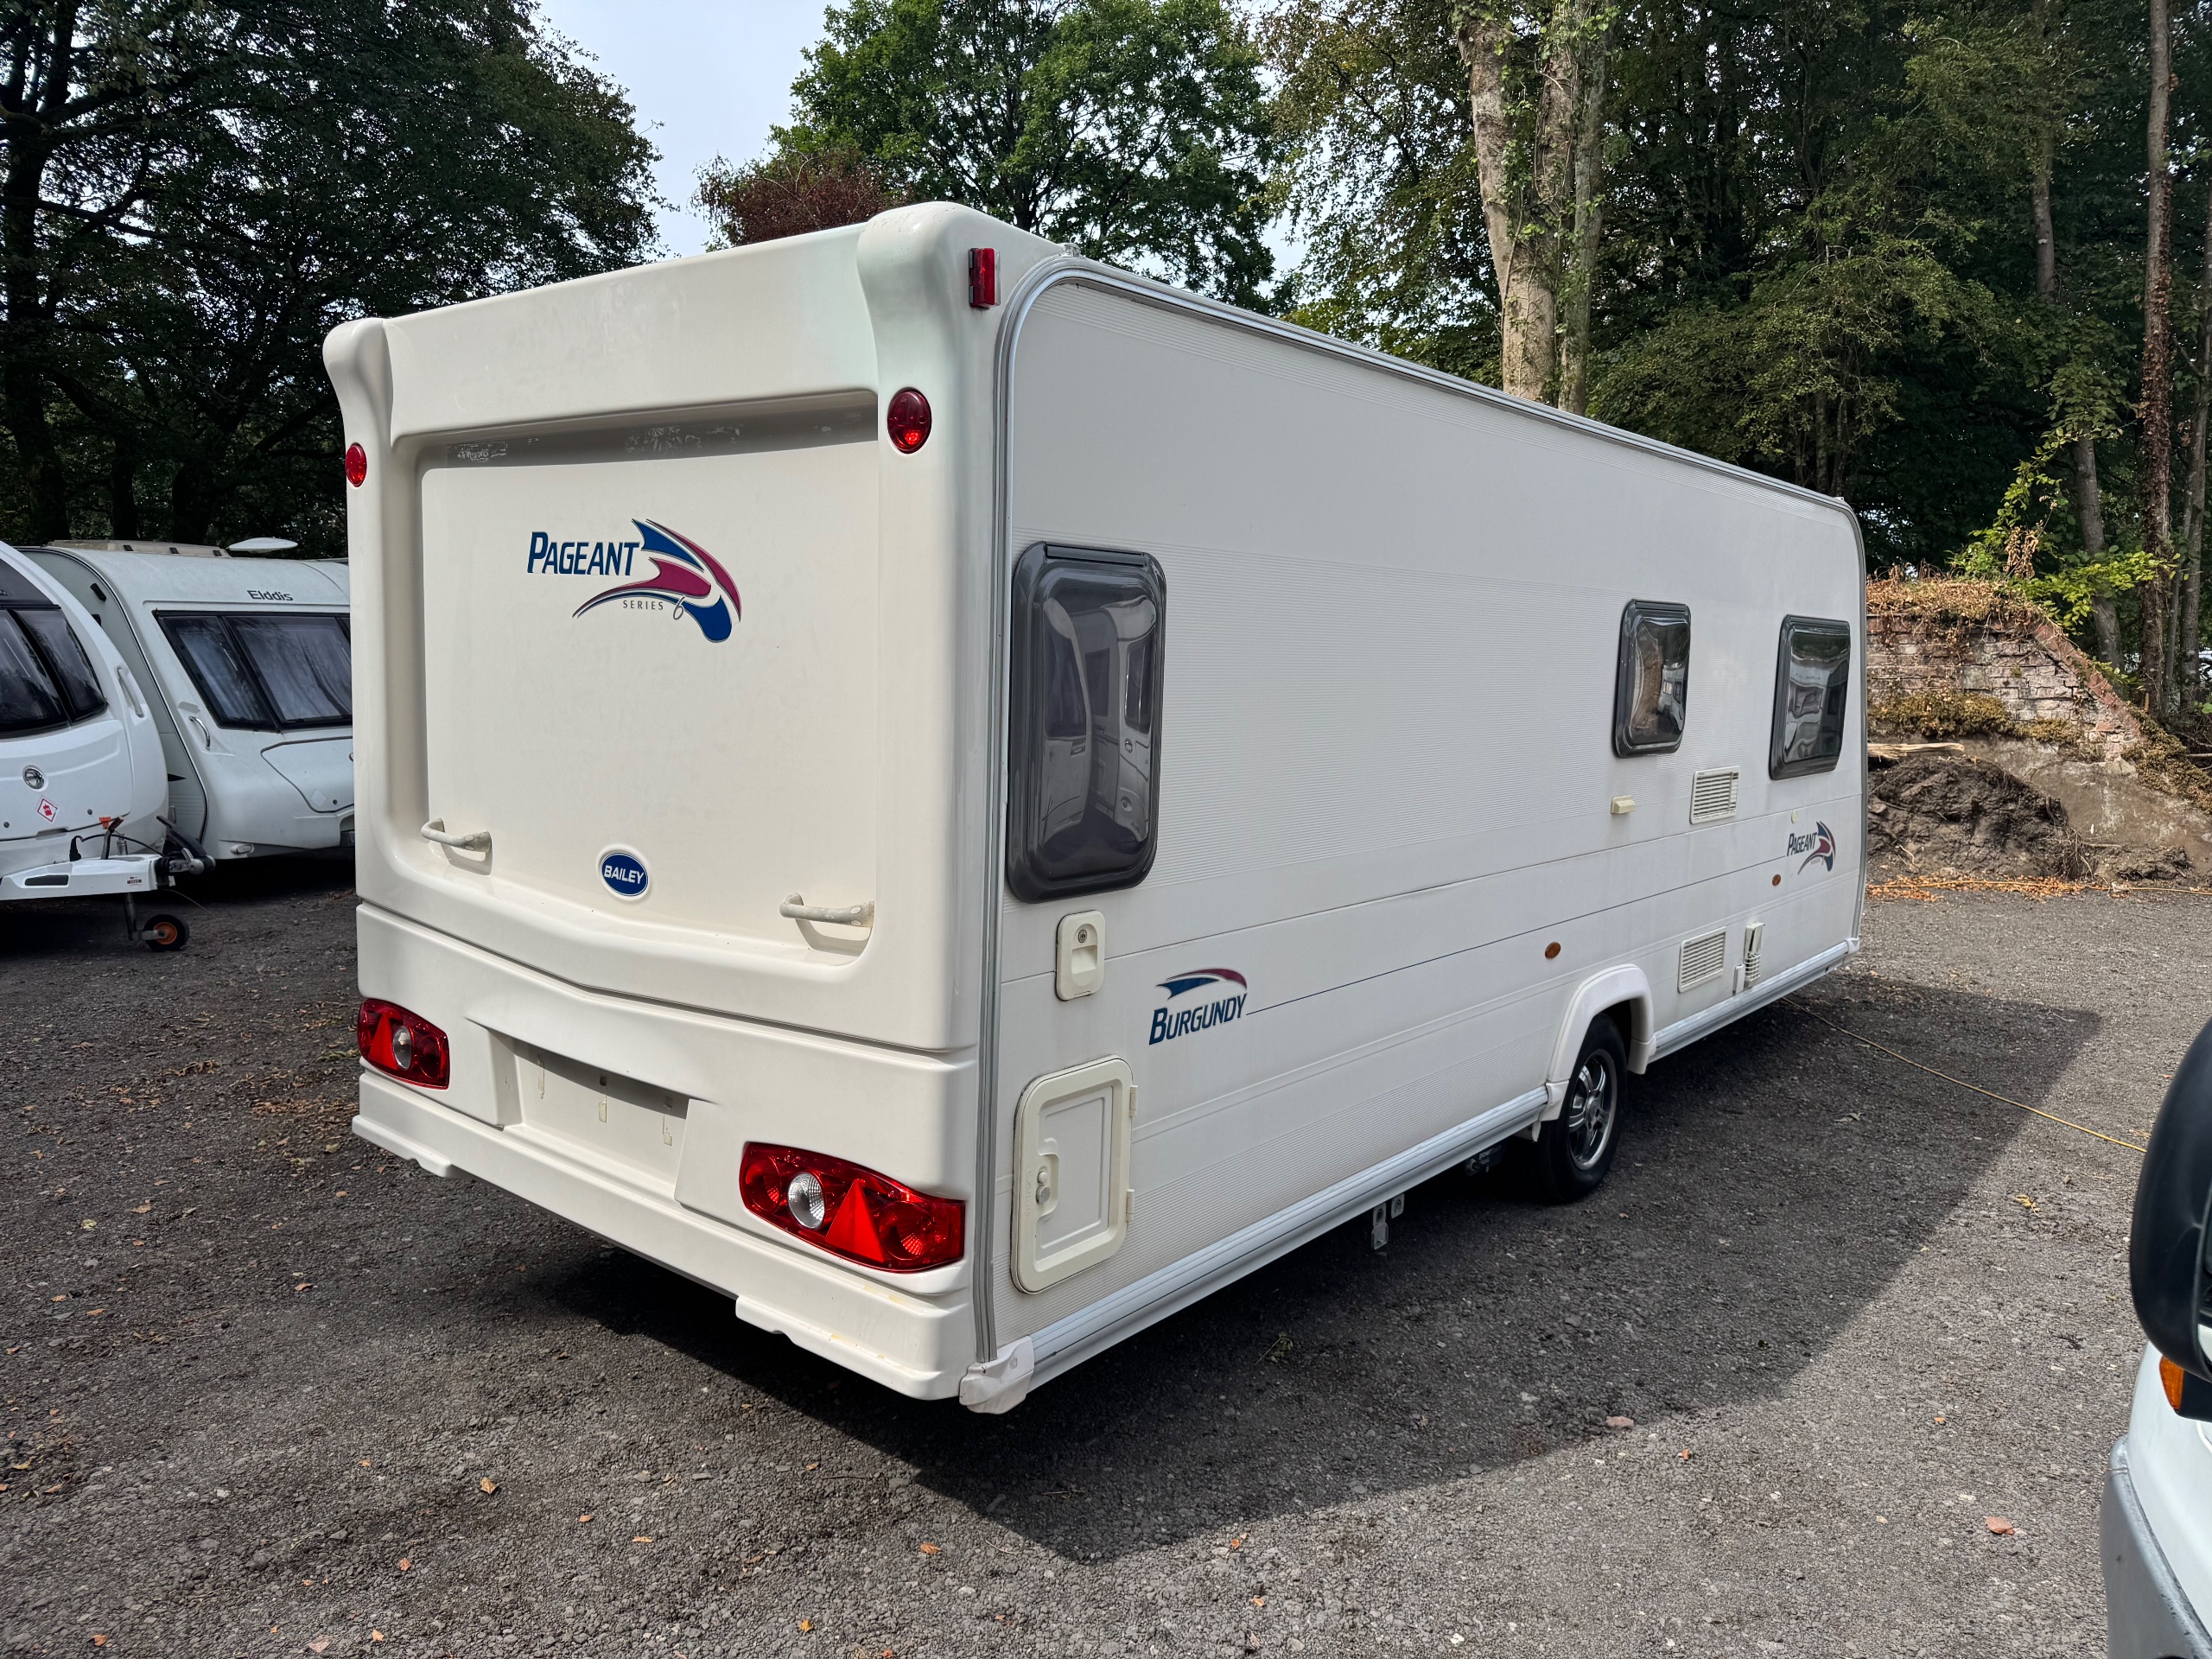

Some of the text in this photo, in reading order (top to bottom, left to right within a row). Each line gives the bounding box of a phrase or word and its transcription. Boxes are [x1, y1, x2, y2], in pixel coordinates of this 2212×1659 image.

[527, 531, 640, 576] PAGEANT
[246, 589, 294, 601] Elddis
[622, 595, 686, 620] SERIES 6
[1786, 831, 1818, 857] PAGEANT
[603, 864, 645, 885] BAILEY
[1148, 993, 1248, 1046] BURGUNDY
